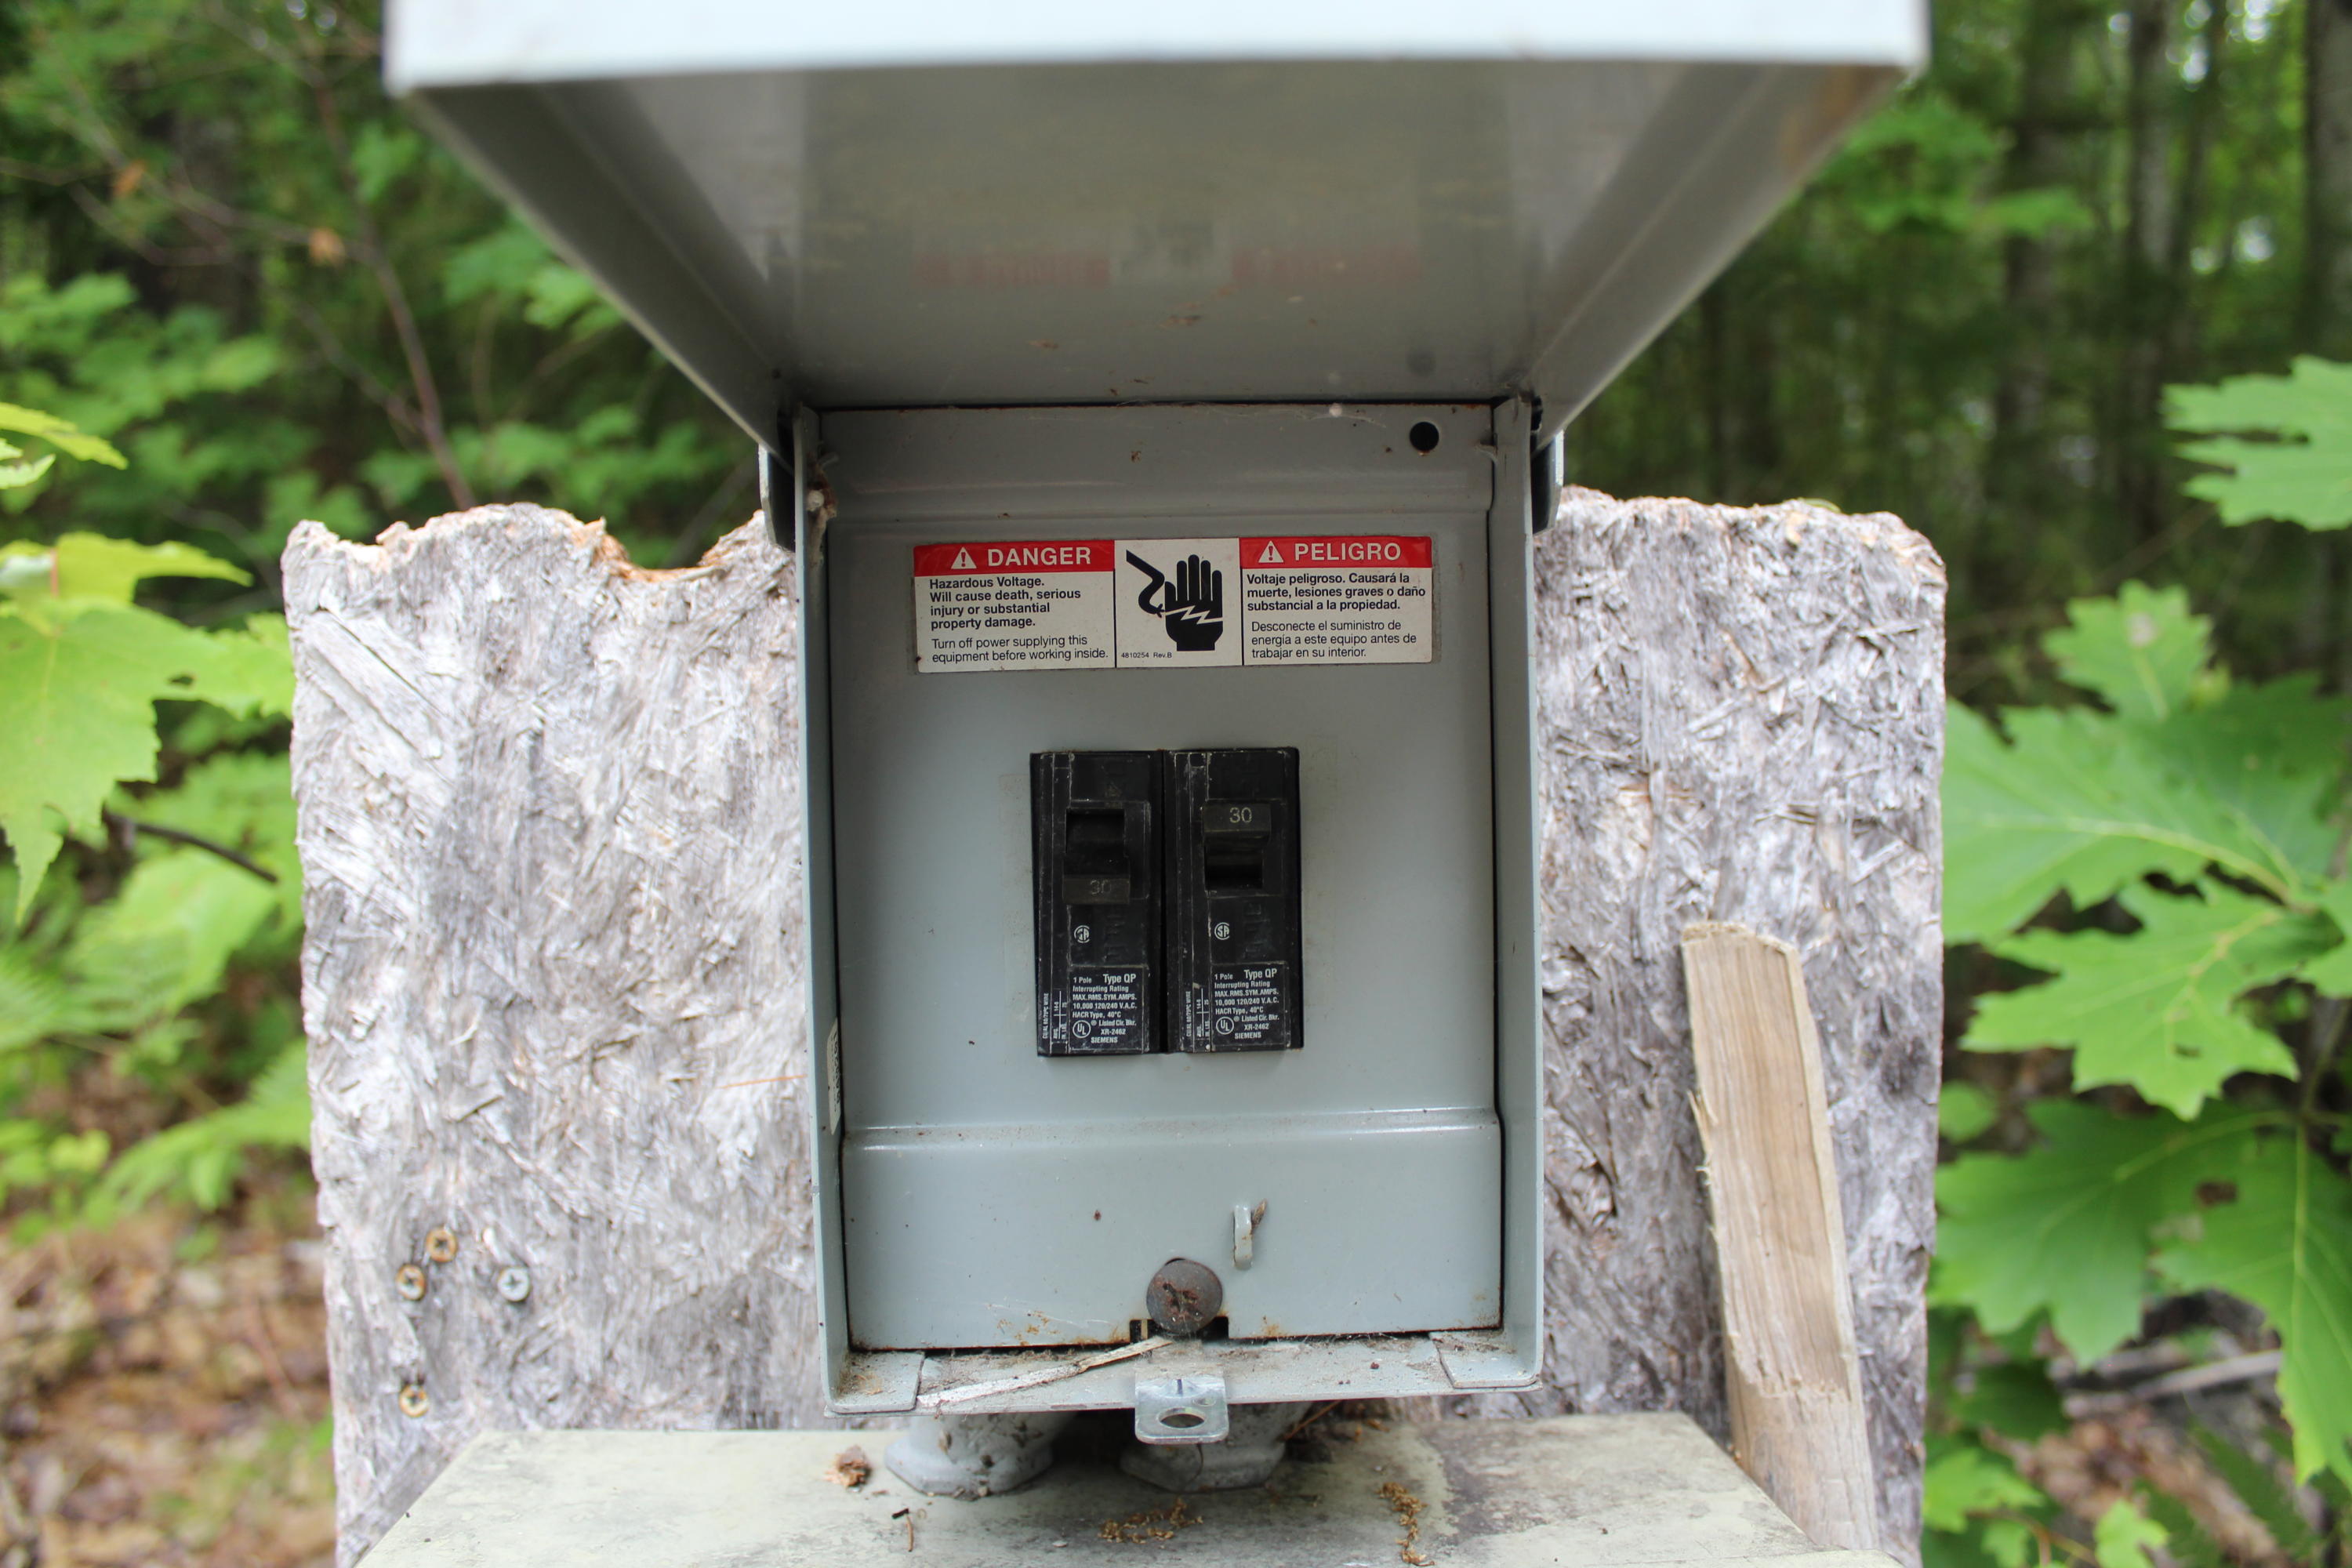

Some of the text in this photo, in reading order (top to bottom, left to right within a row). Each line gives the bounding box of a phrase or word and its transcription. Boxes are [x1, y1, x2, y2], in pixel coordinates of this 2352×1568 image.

[988, 547, 1091, 567] DANGER
[1294, 543, 1401, 561] PELIGRO
[930, 576, 1044, 589] Hazardous Voltage.
[1247, 572, 1409, 586] Voltaje peligroso. Causará la
[930, 589, 1080, 602] Will cause death, serious
[1247, 588, 1291, 599] muerte,
[1295, 586, 1341, 597] lesiones
[1345, 587, 1383, 598] graves
[1397, 586, 1425, 596] daño
[931, 603, 1050, 617] injury or substantial
[1247, 601, 1312, 611] substancial
[1327, 601, 1336, 610] la
[1340, 600, 1400, 612] propiedad.
[931, 618, 1035, 630] property damage.
[1252, 619, 1401, 631] Desconecte el suministro de
[931, 635, 1087, 649] Turn off power supplying this
[1252, 633, 1416, 647] energía a este equipo antes de
[932, 648, 1108, 663] equipment before working inside.
[1252, 646, 1367, 660] trabajar en su interior.
[1229, 807, 1252, 823] 30
[1090, 879, 1112, 895] 30
[1103, 974, 1136, 984] Type QP
[1243, 968, 1277, 980] Type QP
